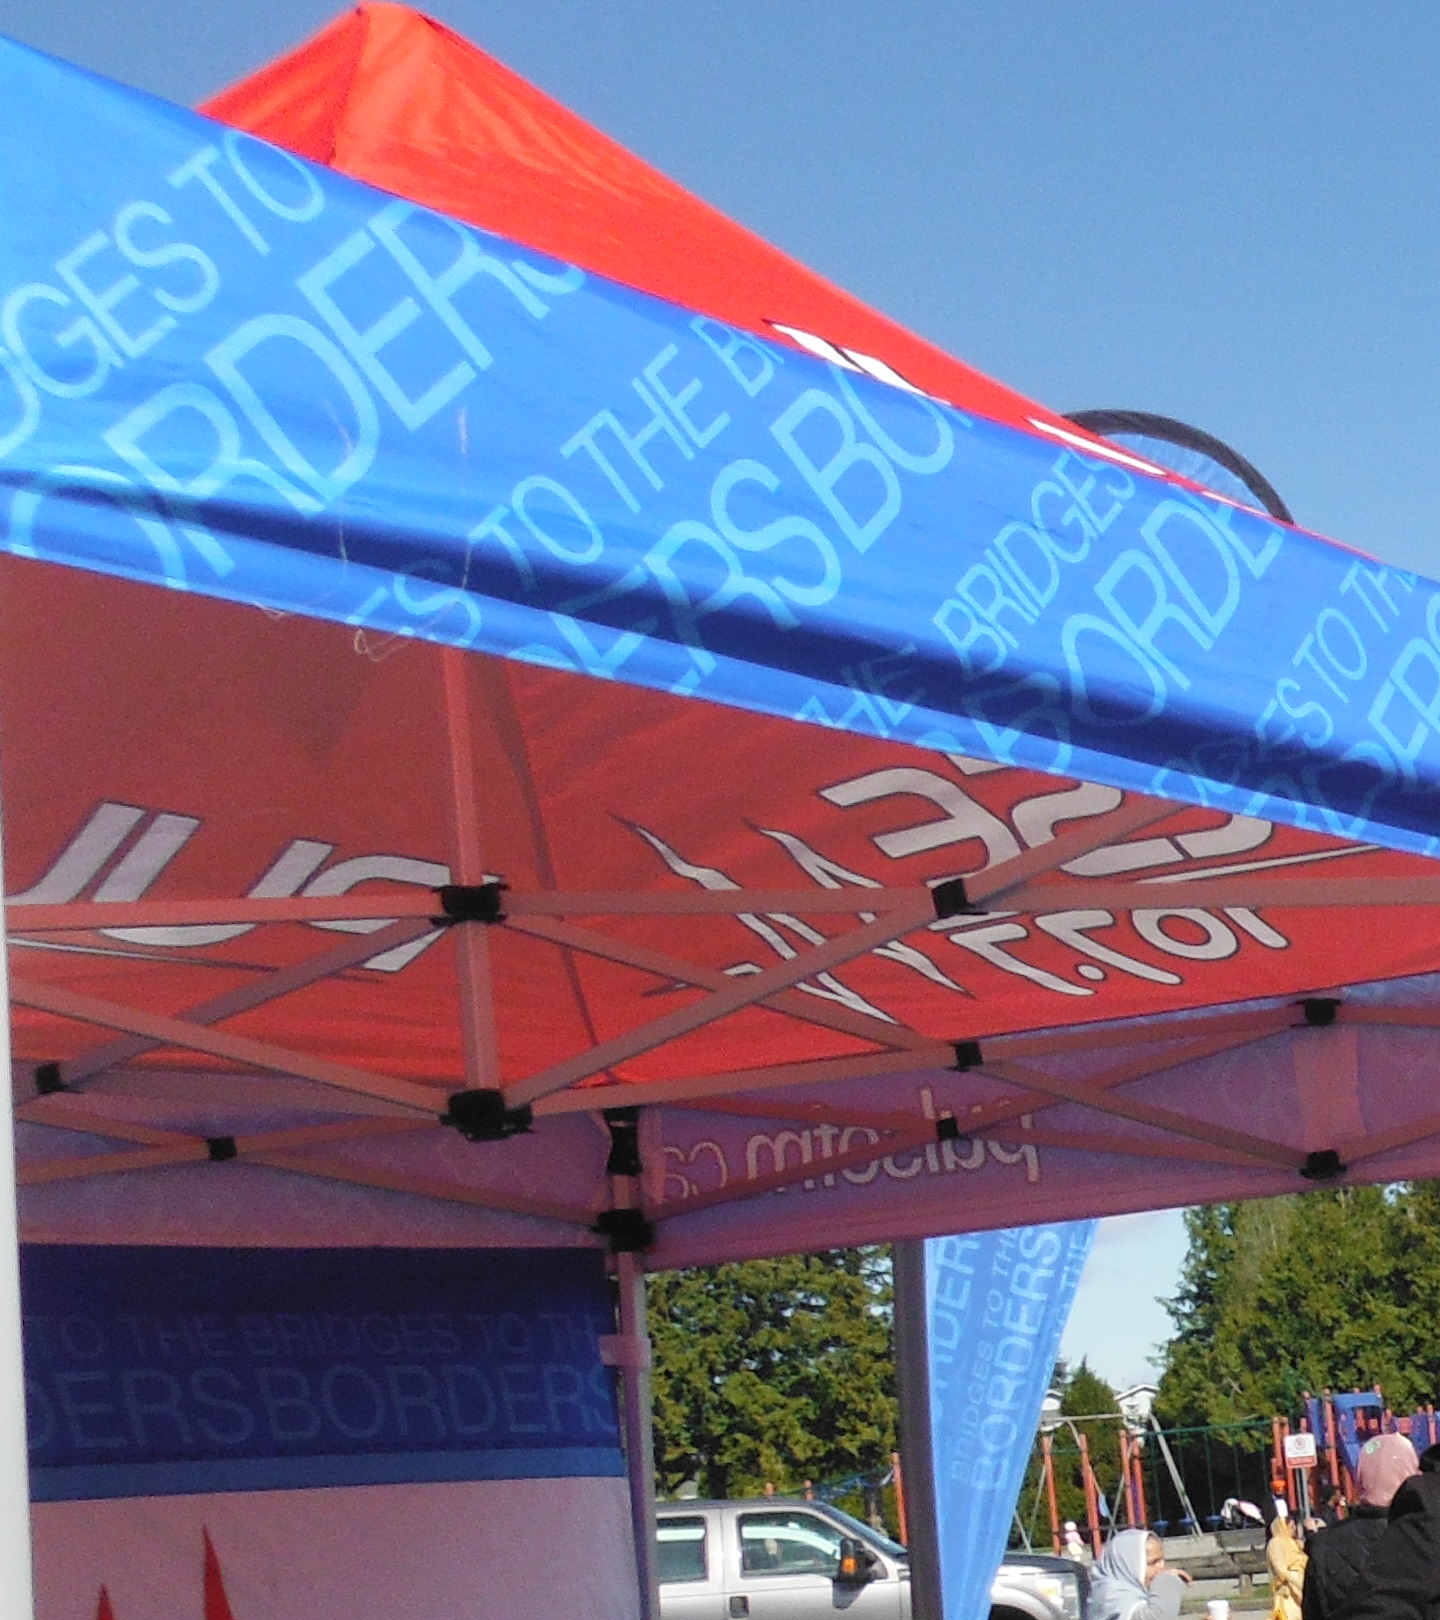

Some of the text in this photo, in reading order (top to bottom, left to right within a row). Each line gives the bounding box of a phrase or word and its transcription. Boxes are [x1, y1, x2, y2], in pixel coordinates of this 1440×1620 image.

[166, 132, 325, 256] TO
[468, 475, 605, 592] TO
[560, 343, 731, 513] THE
[932, 449, 1137, 680] BRIDGES
[1292, 607, 1368, 703] TO
